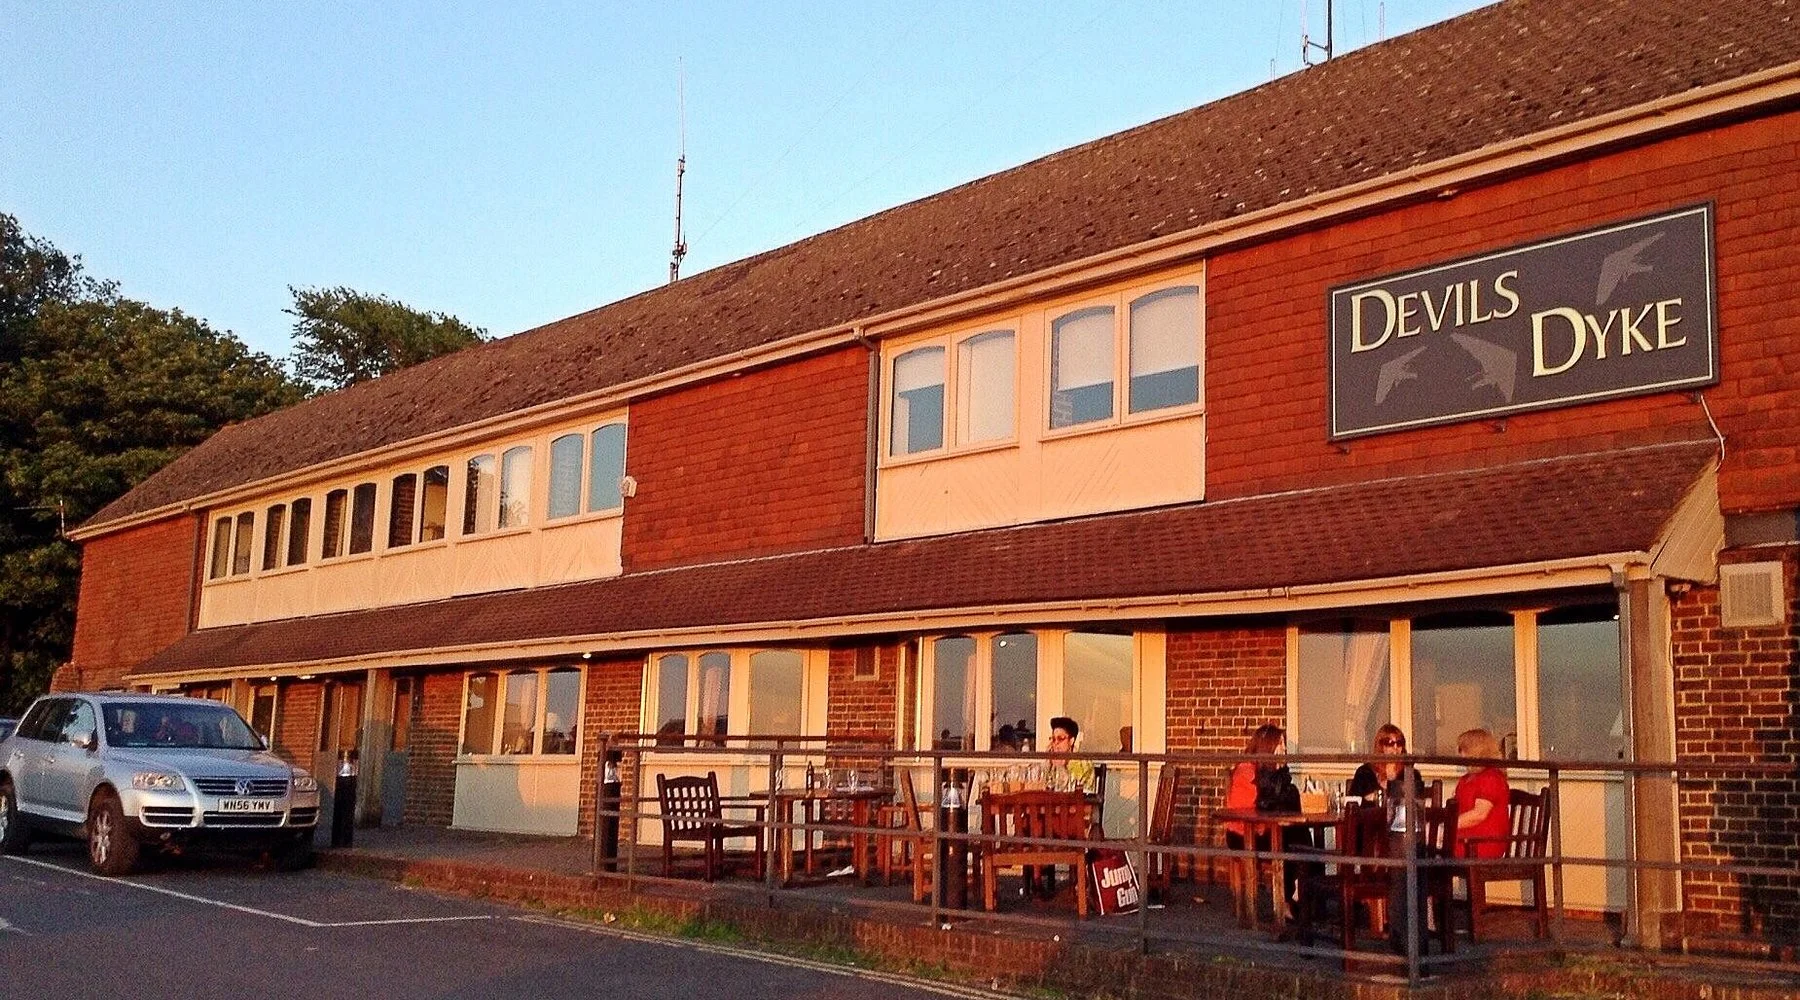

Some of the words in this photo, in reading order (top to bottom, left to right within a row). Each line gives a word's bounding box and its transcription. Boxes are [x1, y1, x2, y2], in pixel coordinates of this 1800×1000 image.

[1351, 271, 1519, 353] DEVILS
[1531, 298, 1687, 377] DYKE
[223, 800, 249, 811] WN56
[252, 800, 271, 811] YMV
